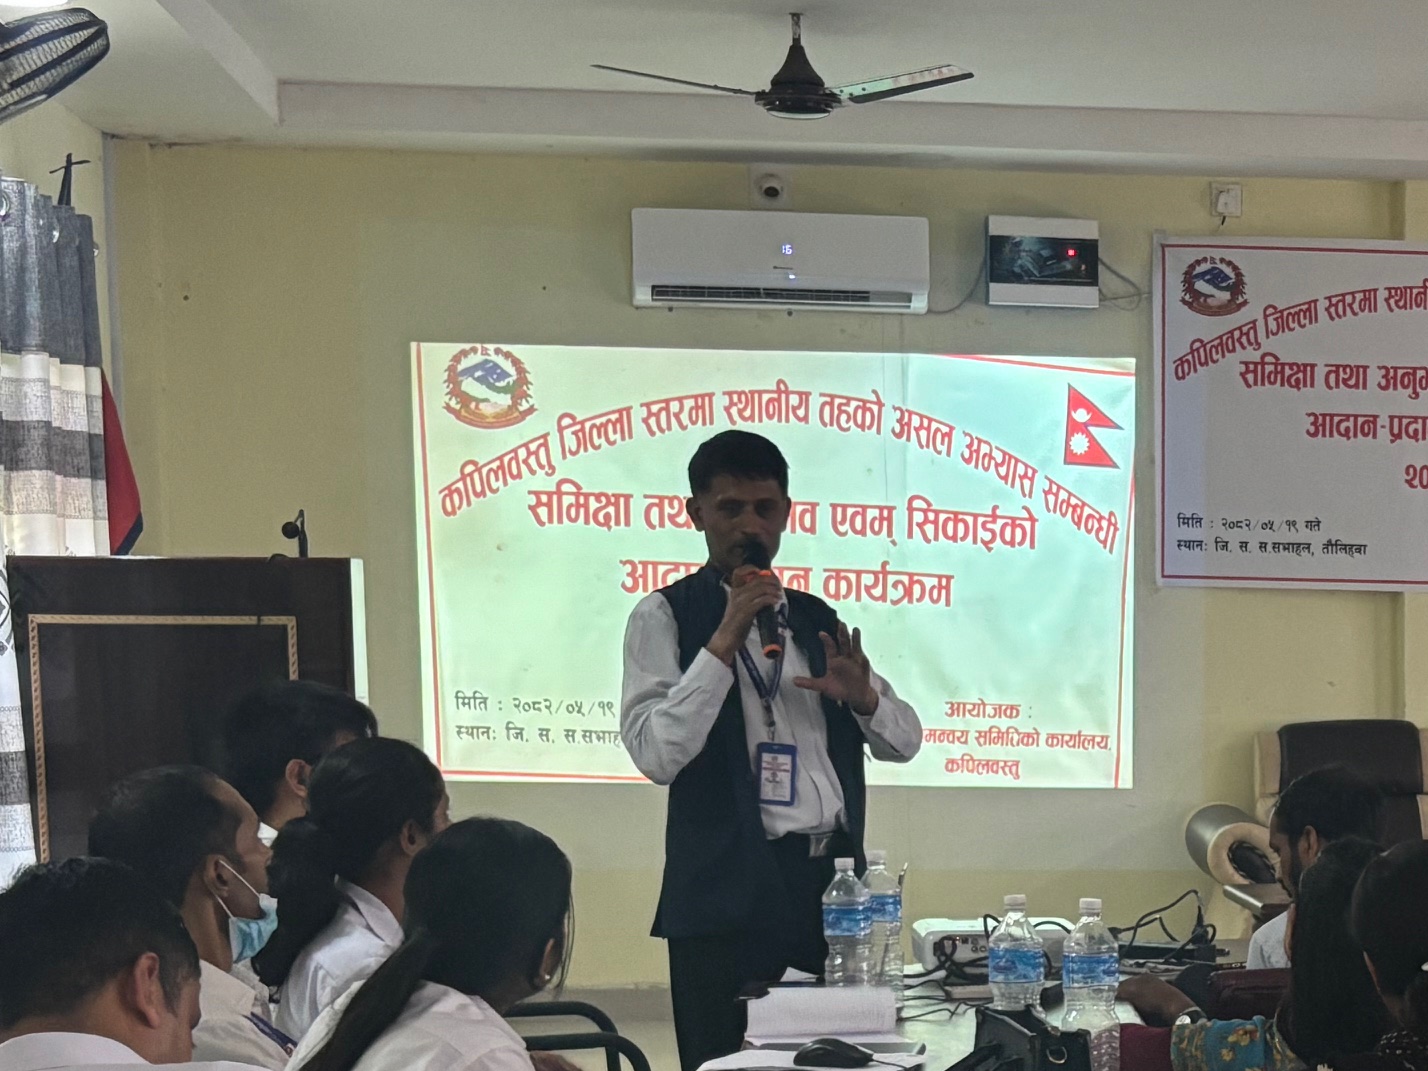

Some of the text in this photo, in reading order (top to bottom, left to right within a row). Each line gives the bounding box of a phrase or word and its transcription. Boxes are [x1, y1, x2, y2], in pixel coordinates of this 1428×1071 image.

[1173, 319, 1262, 381] कपिलवस्तु
[1263, 299, 1319, 339] जिल्ला
[1324, 288, 1379, 322] स्तरमा
[1239, 352, 1317, 391] समिक्षा
[1324, 363, 1370, 391] तथा
[438, 378, 1120, 554] कपिलवस्तु जिल्ला स्तरमा स्थानीय तहको असल अभ्यास सम्बन्धी
[528, 478, 633, 531] समिक्षा
[643, 494, 696, 531] तथ
[829, 502, 897, 546] एवम्
[906, 494, 1039, 553] सिकाईको
[1177, 512, 1203, 529] मिति
[1305, 517, 1322, 531] गते
[1214, 537, 1232, 553] जि.
[1239, 541, 1252, 553] स.
[823, 560, 955, 607] कार्यक्रम
[455, 690, 489, 712] मिति
[945, 698, 1021, 719] आयोजक
[505, 721, 529, 743] जि.
[538, 727, 555, 744] स.
[921, 728, 970, 746] मन्वय
[974, 725, 1041, 747] समितिको
[945, 753, 1020, 780] कपिलवस्तु
